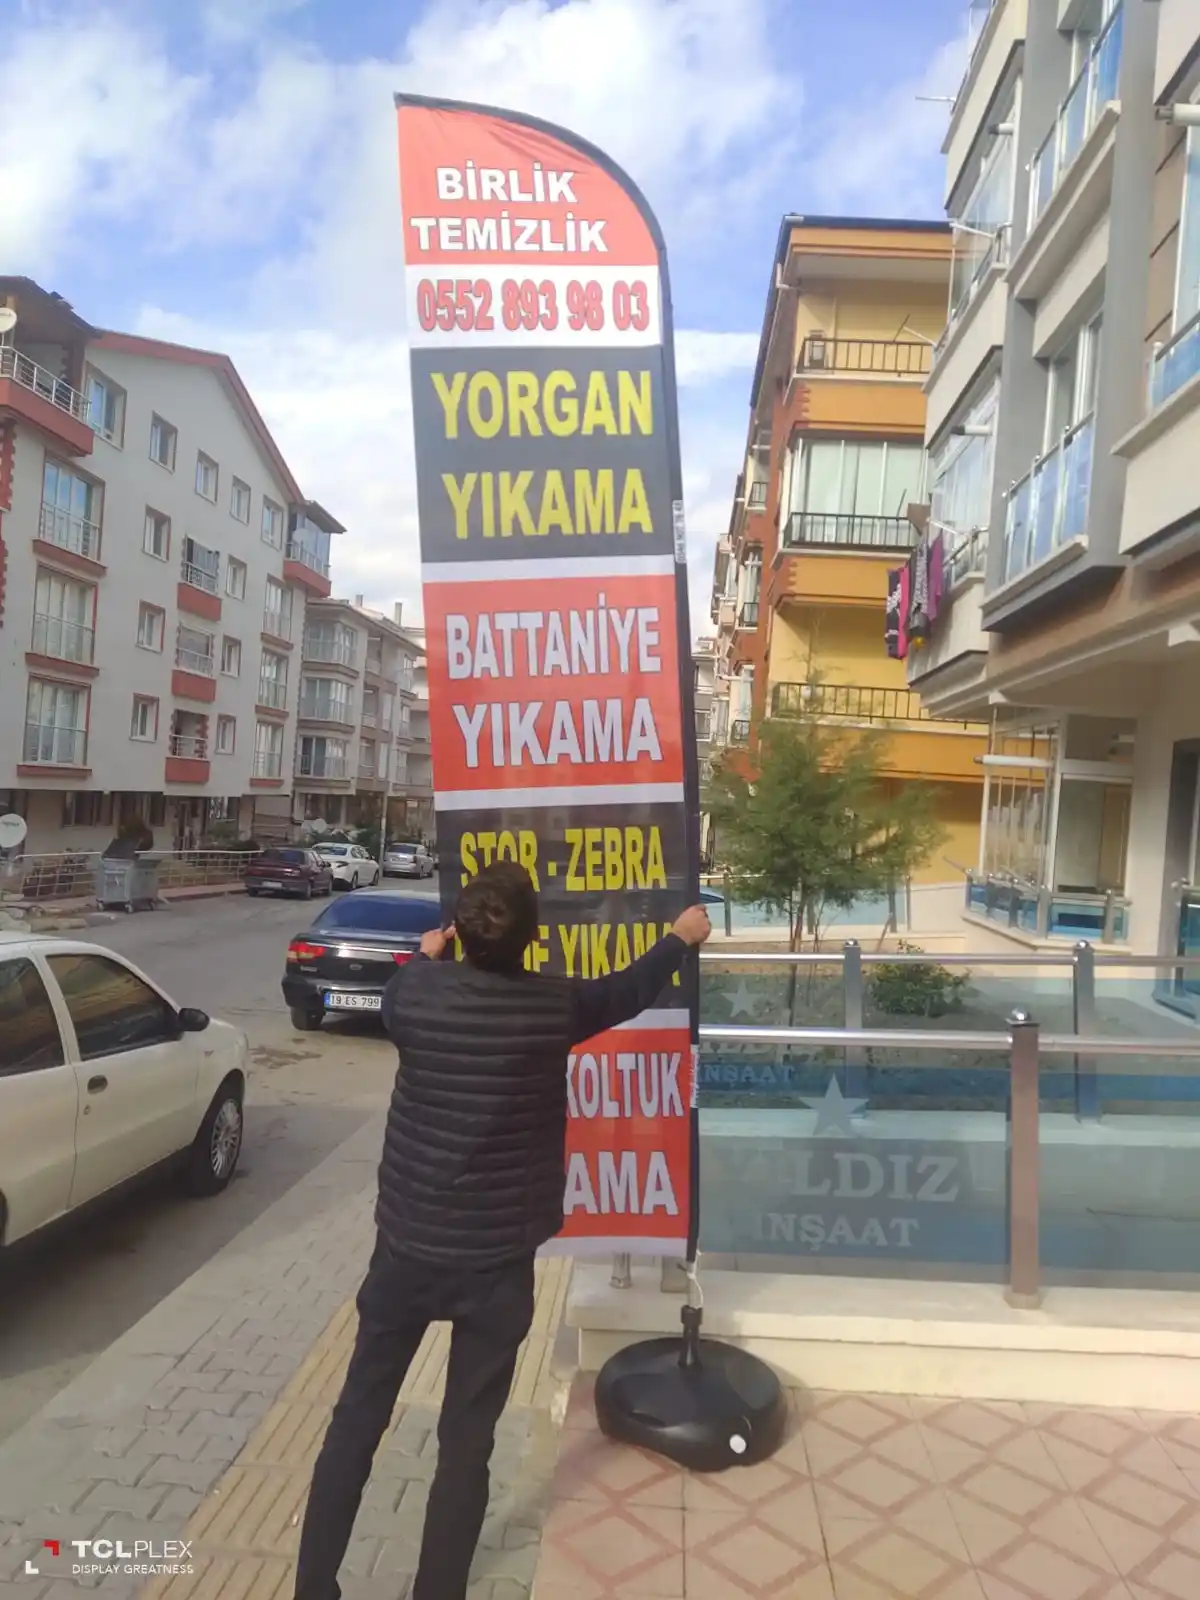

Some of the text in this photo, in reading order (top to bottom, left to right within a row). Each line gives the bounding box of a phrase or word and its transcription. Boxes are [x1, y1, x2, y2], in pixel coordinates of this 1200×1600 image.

[436, 160, 578, 203] BİRLİK
[410, 211, 608, 252] TEMİZLİK
[417, 278, 650, 331] 0552 893 98 03
[430, 370, 653, 439] YORGAN
[441, 468, 654, 539] YIKAMA
[446, 592, 661, 679] BATTANİYE
[452, 698, 663, 767] YIKAMA
[564, 826, 667, 892] ZEBRA
[331, 995, 342, 1005] 19
[345, 996, 357, 1006] ES
[562, 1151, 679, 1216] AMA
